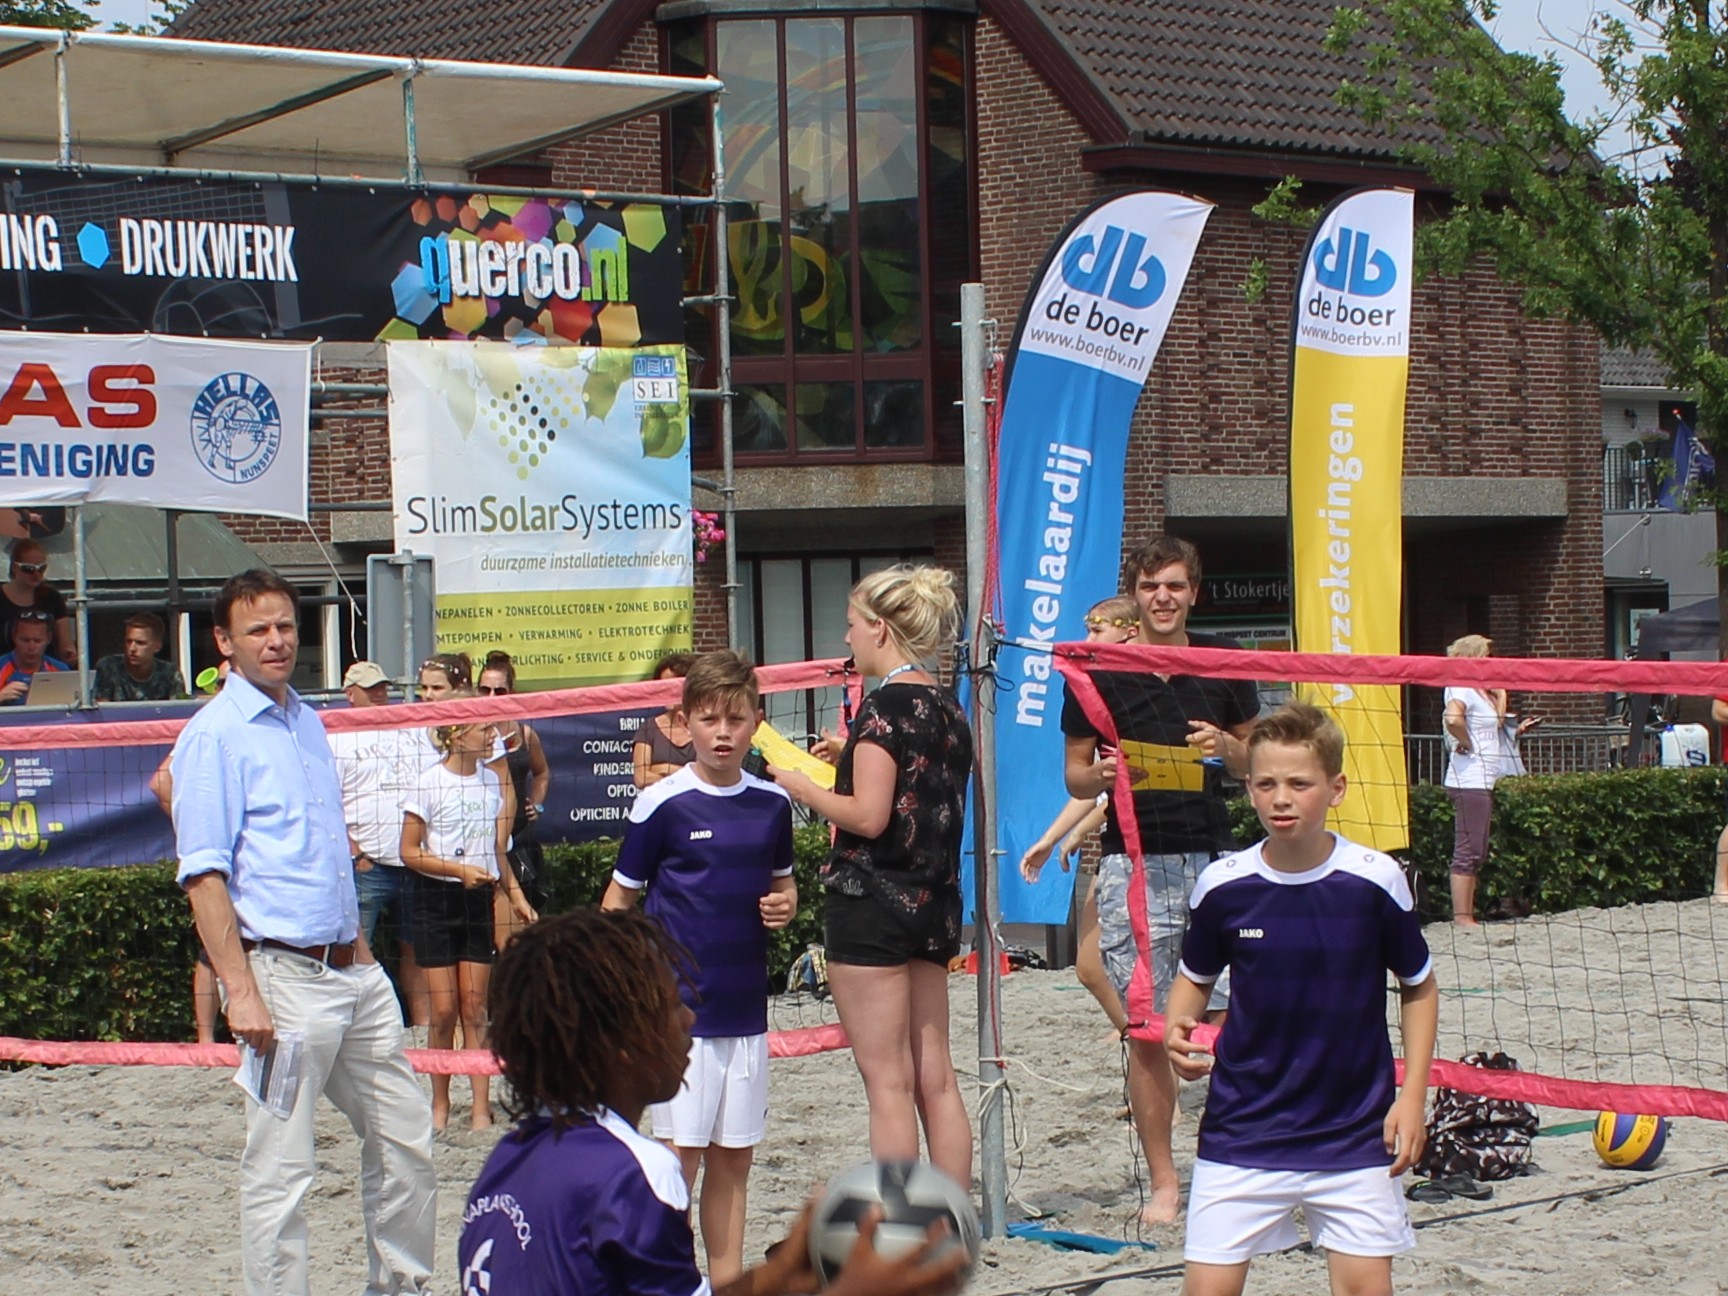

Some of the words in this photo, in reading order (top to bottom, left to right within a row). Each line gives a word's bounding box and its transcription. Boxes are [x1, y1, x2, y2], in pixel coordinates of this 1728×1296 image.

[119, 217, 299, 283] DRUKWERK
[1046, 293, 1080, 325] de
[1086, 301, 1149, 346] boer
[1308, 291, 1332, 319] de
[1336, 295, 1396, 326] boer
[1301, 325, 1402, 347] www.boerbv.nl
[1030, 327, 1145, 371] www.boerbv.nl
[637, 380, 674, 399] SEI
[239, 432, 279, 480] NUNSPEET
[407, 494, 682, 541] SlimSolarSystems
[480, 553, 547, 572] duurzame
[550, 551, 685, 569] installatietechnieken
[1319, 402, 1363, 705] vrzekeringen
[1016, 443, 1092, 727] makelaardij
[436, 608, 493, 619] NEPANELEN
[505, 603, 605, 617] ZONNECOLLECTOREN
[616, 601, 649, 613] ZONNE
[653, 600, 688, 611] BOILER
[436, 631, 502, 644] MTEPOMPEN
[518, 628, 583, 641] VERWARMING
[598, 624, 689, 638] ELEKTROTECHNIEK
[512, 653, 565, 666] RLICHTING
[575, 652, 614, 664] SERVICE
[618, 652, 625, 662] &
[570, 807, 620, 822] OPTICIEN
[689, 830, 712, 840] JAKO
[1239, 928, 1264, 938] JAKO
